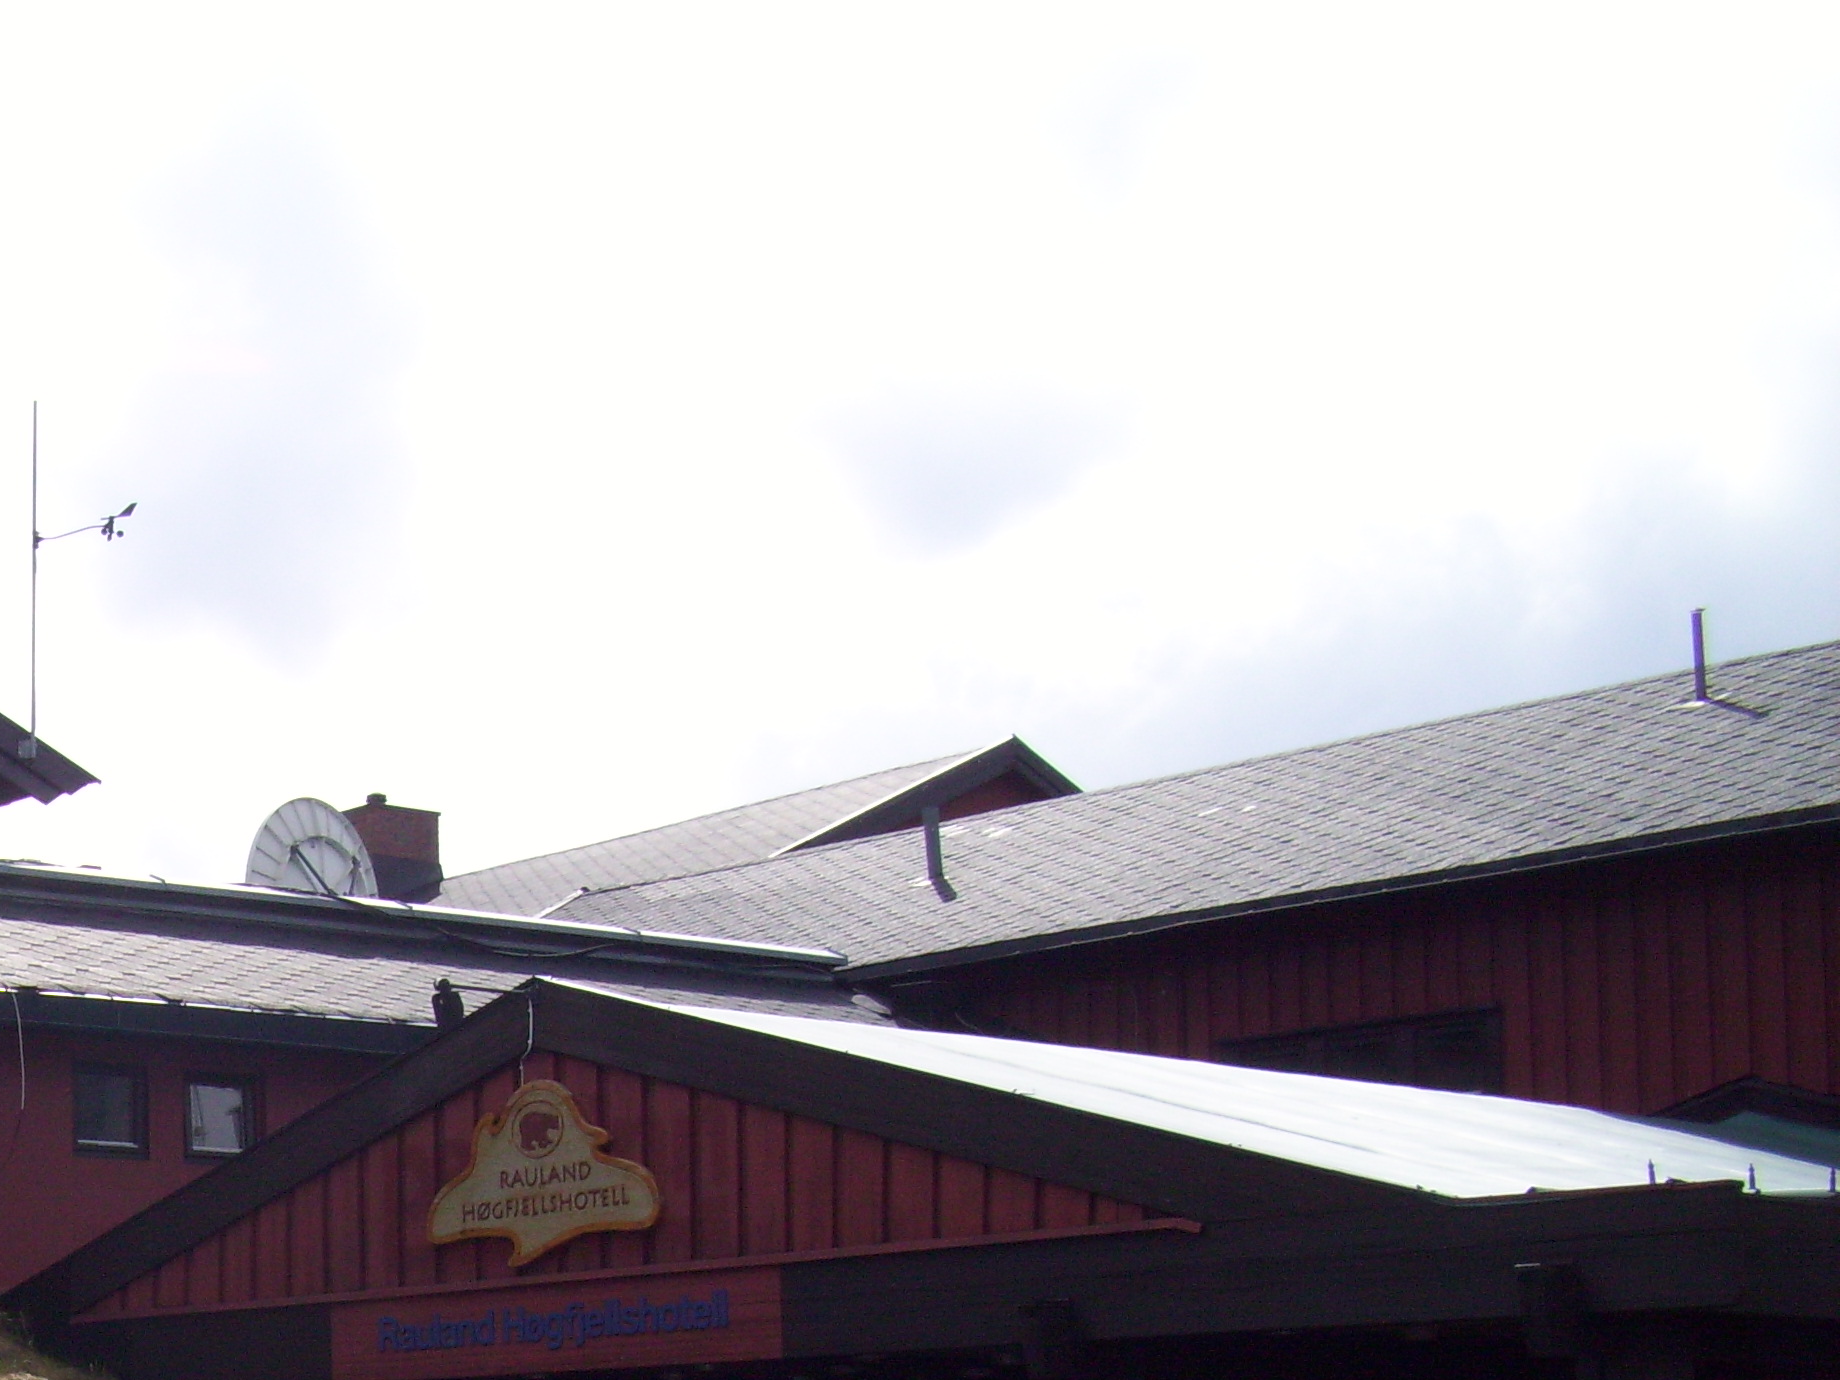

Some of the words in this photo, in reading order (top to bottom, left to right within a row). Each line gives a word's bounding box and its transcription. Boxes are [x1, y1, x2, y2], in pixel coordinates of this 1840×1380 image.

[500, 1160, 592, 1190] RAULAND
[461, 1186, 631, 1224] HØGFJELLSHOTELL
[377, 1308, 496, 1351] Rauland
